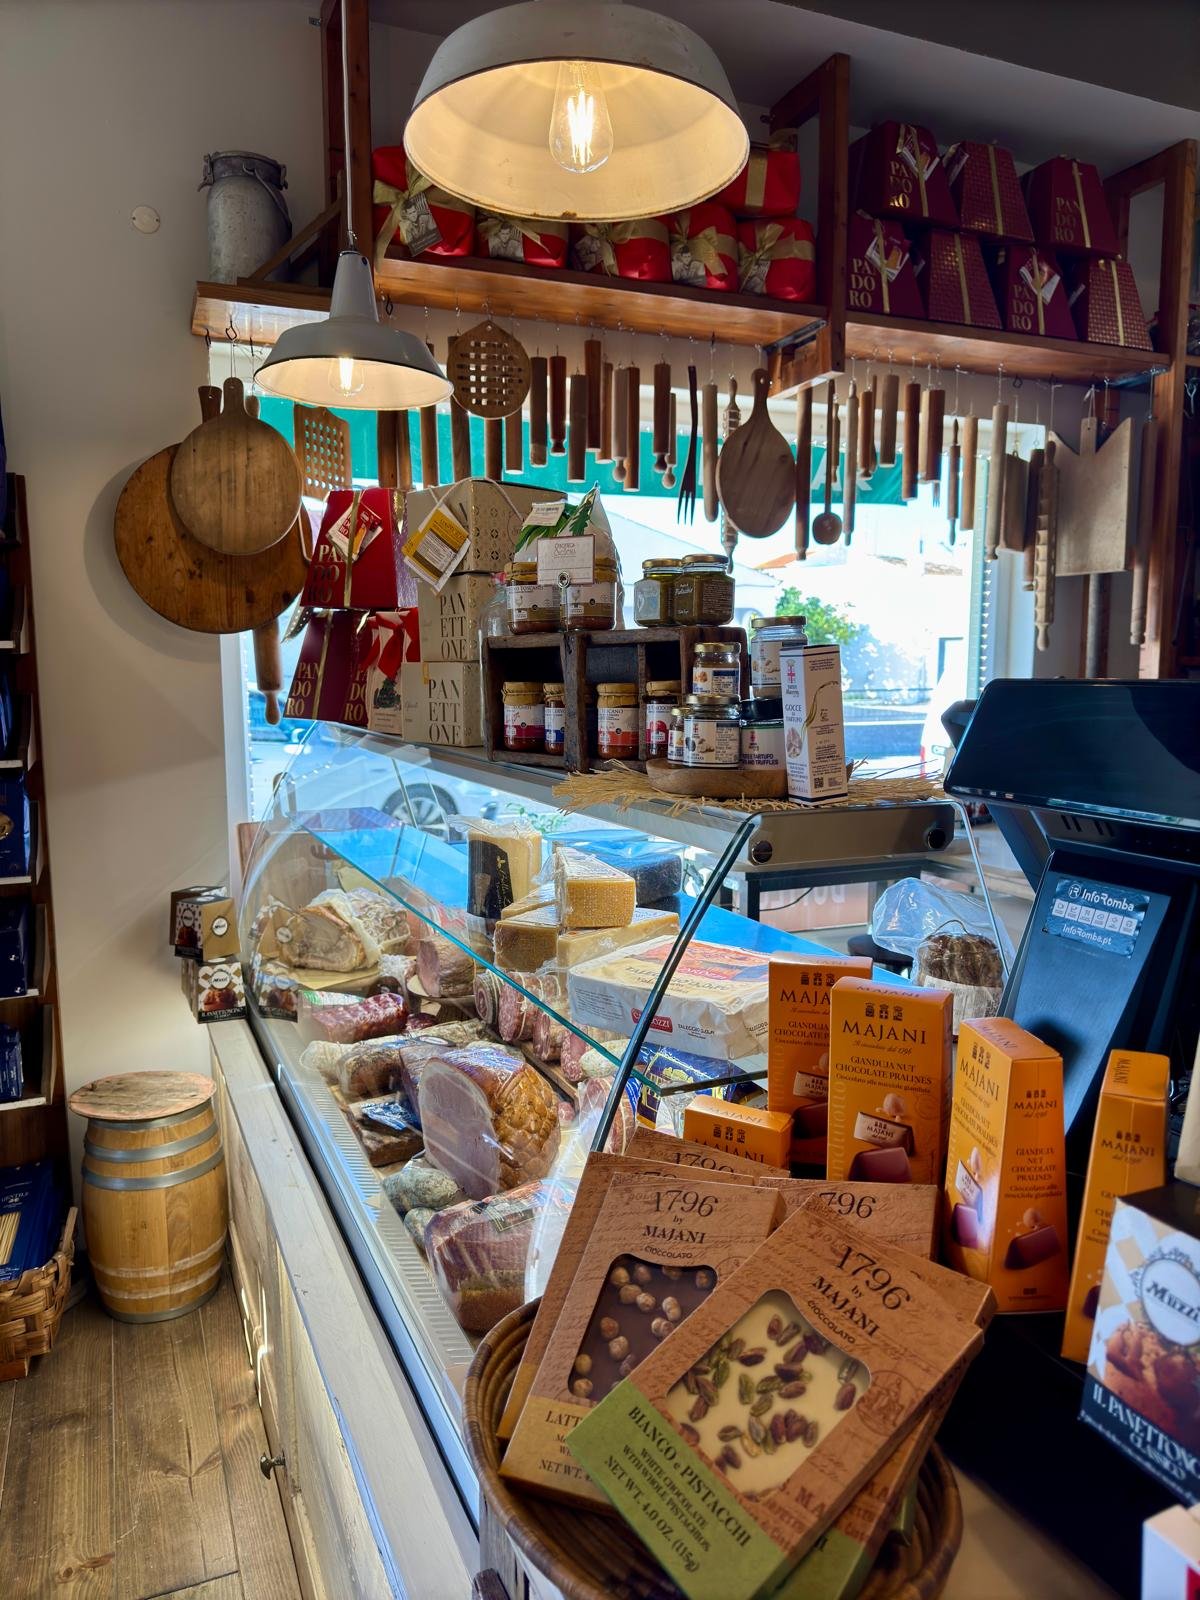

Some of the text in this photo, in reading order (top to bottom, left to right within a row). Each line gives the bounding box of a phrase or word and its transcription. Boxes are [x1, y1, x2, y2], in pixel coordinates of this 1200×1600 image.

[851, 273, 876, 292] DO
[849, 289, 873, 309] RO
[1013, 299, 1034, 316] DO
[1012, 313, 1032, 331] RO
[319, 543, 345, 563] PA
[440, 592, 467, 615] PAN
[440, 616, 467, 638] ETT
[440, 639, 468, 660] ONE
[292, 681, 312, 697] DO
[428, 678, 461, 699] PAN
[285, 697, 305, 716] RO
[344, 703, 364, 721] RO
[428, 701, 461, 723] ETT
[428, 722, 462, 745] ONE
[856, 986, 920, 998] MAJANI
[774, 1028, 824, 1040] CHOCOLATE
[842, 1020, 927, 1045] MAJANI
[835, 1063, 932, 1086] CHOCOLATE PRALINES
[896, 1063, 916, 1073] NUT
[959, 1057, 1000, 1101] MAJANI
[1013, 1100, 1058, 1110] MAJANI
[866, 1125, 894, 1138] MAJANI
[1101, 1138, 1156, 1158] MAJANI
[1011, 1164, 1057, 1174] CHOCOLATE
[654, 1189, 719, 1218] 1796
[673, 1214, 685, 1225] by
[642, 1224, 707, 1245] MAJANI
[644, 1244, 694, 1260] CIOCCOLATO
[835, 1245, 911, 1311] 1796
[851, 1284, 865, 1300] by
[1145, 1280, 1200, 1323] Muzzi
[811, 1275, 881, 1339] MAJANI
[807, 1299, 857, 1345] CIOCCOLATO
[1093, 1383, 1107, 1408] IL
[538, 1458, 563, 1475] NET
[563, 1463, 583, 1480] WT.
[628, 1405, 752, 1548] BIANCO e PISTACCHI
[622, 1443, 712, 1552] WITH WHOLE PISTACHIOS
[639, 1447, 709, 1530] WHITE CHOCOLATE
[603, 1454, 701, 1574] NET WT. 4.0 OZ. (115g)
